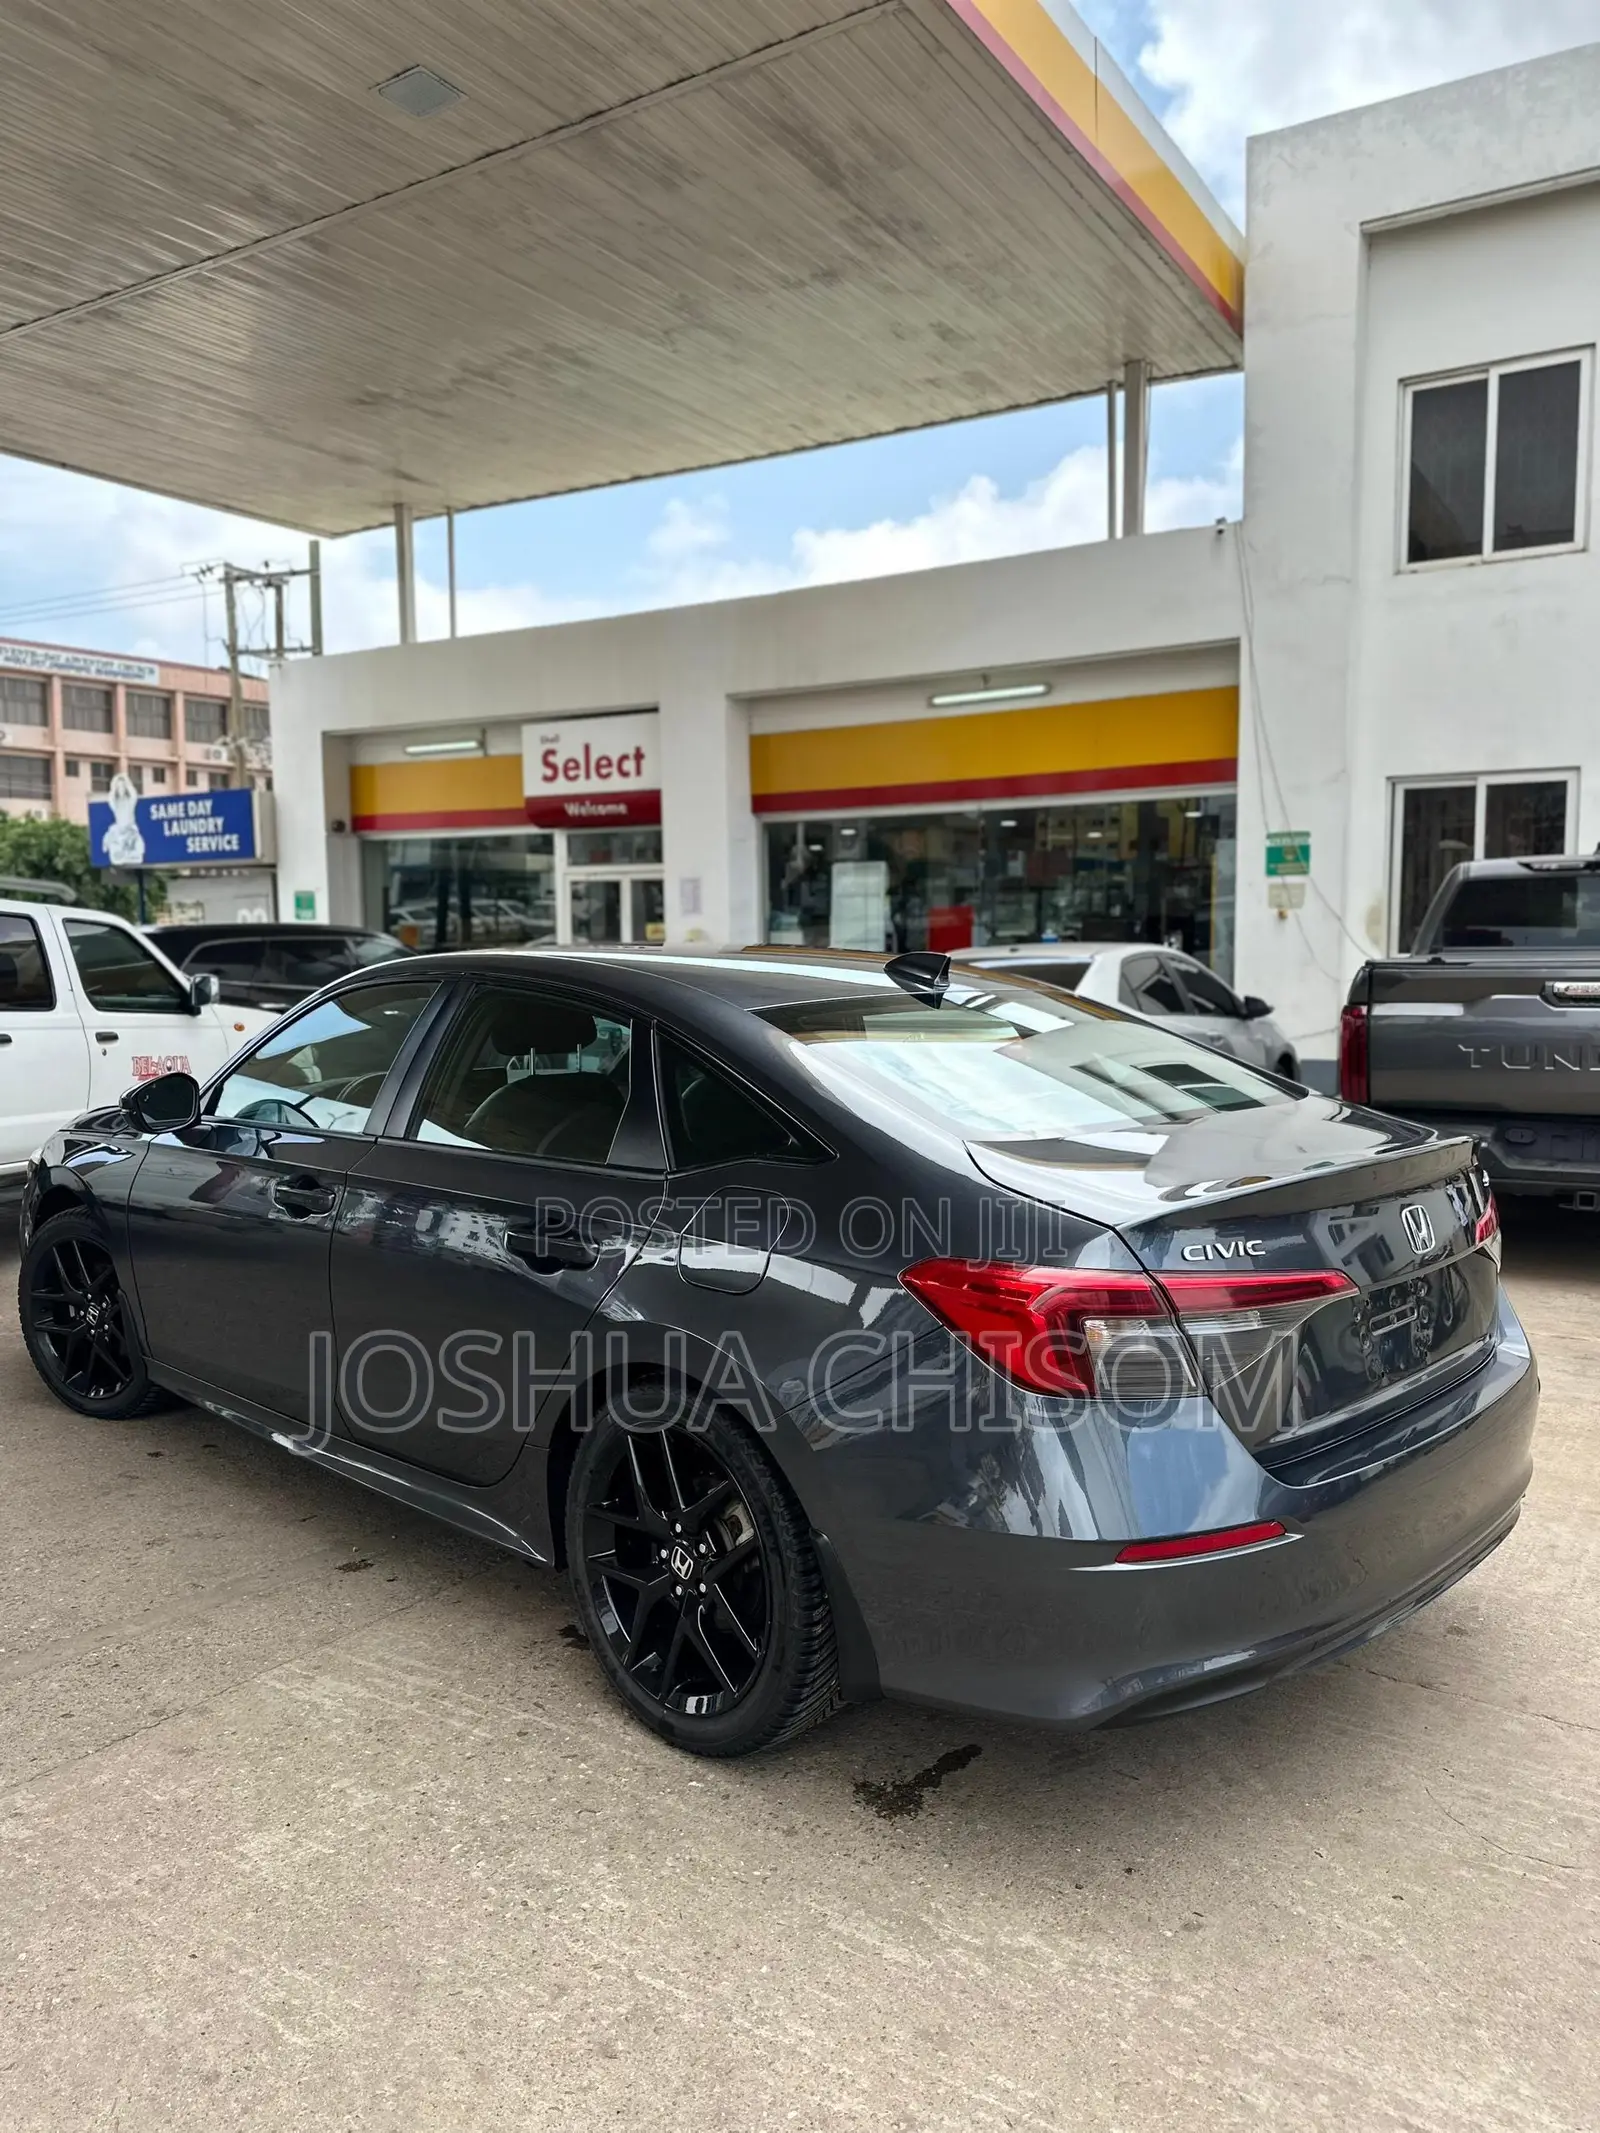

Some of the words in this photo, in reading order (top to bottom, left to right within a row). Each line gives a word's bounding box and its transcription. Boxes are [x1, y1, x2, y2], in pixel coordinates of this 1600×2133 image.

[541, 742, 645, 783] Select
[150, 802, 185, 820] SAME
[187, 799, 213, 817] DAY
[564, 800, 628, 817] Welcome
[163, 816, 224, 836] LAUNDRY
[186, 834, 239, 853] SERVICE
[1182, 1239, 1267, 1262] CIVIC
